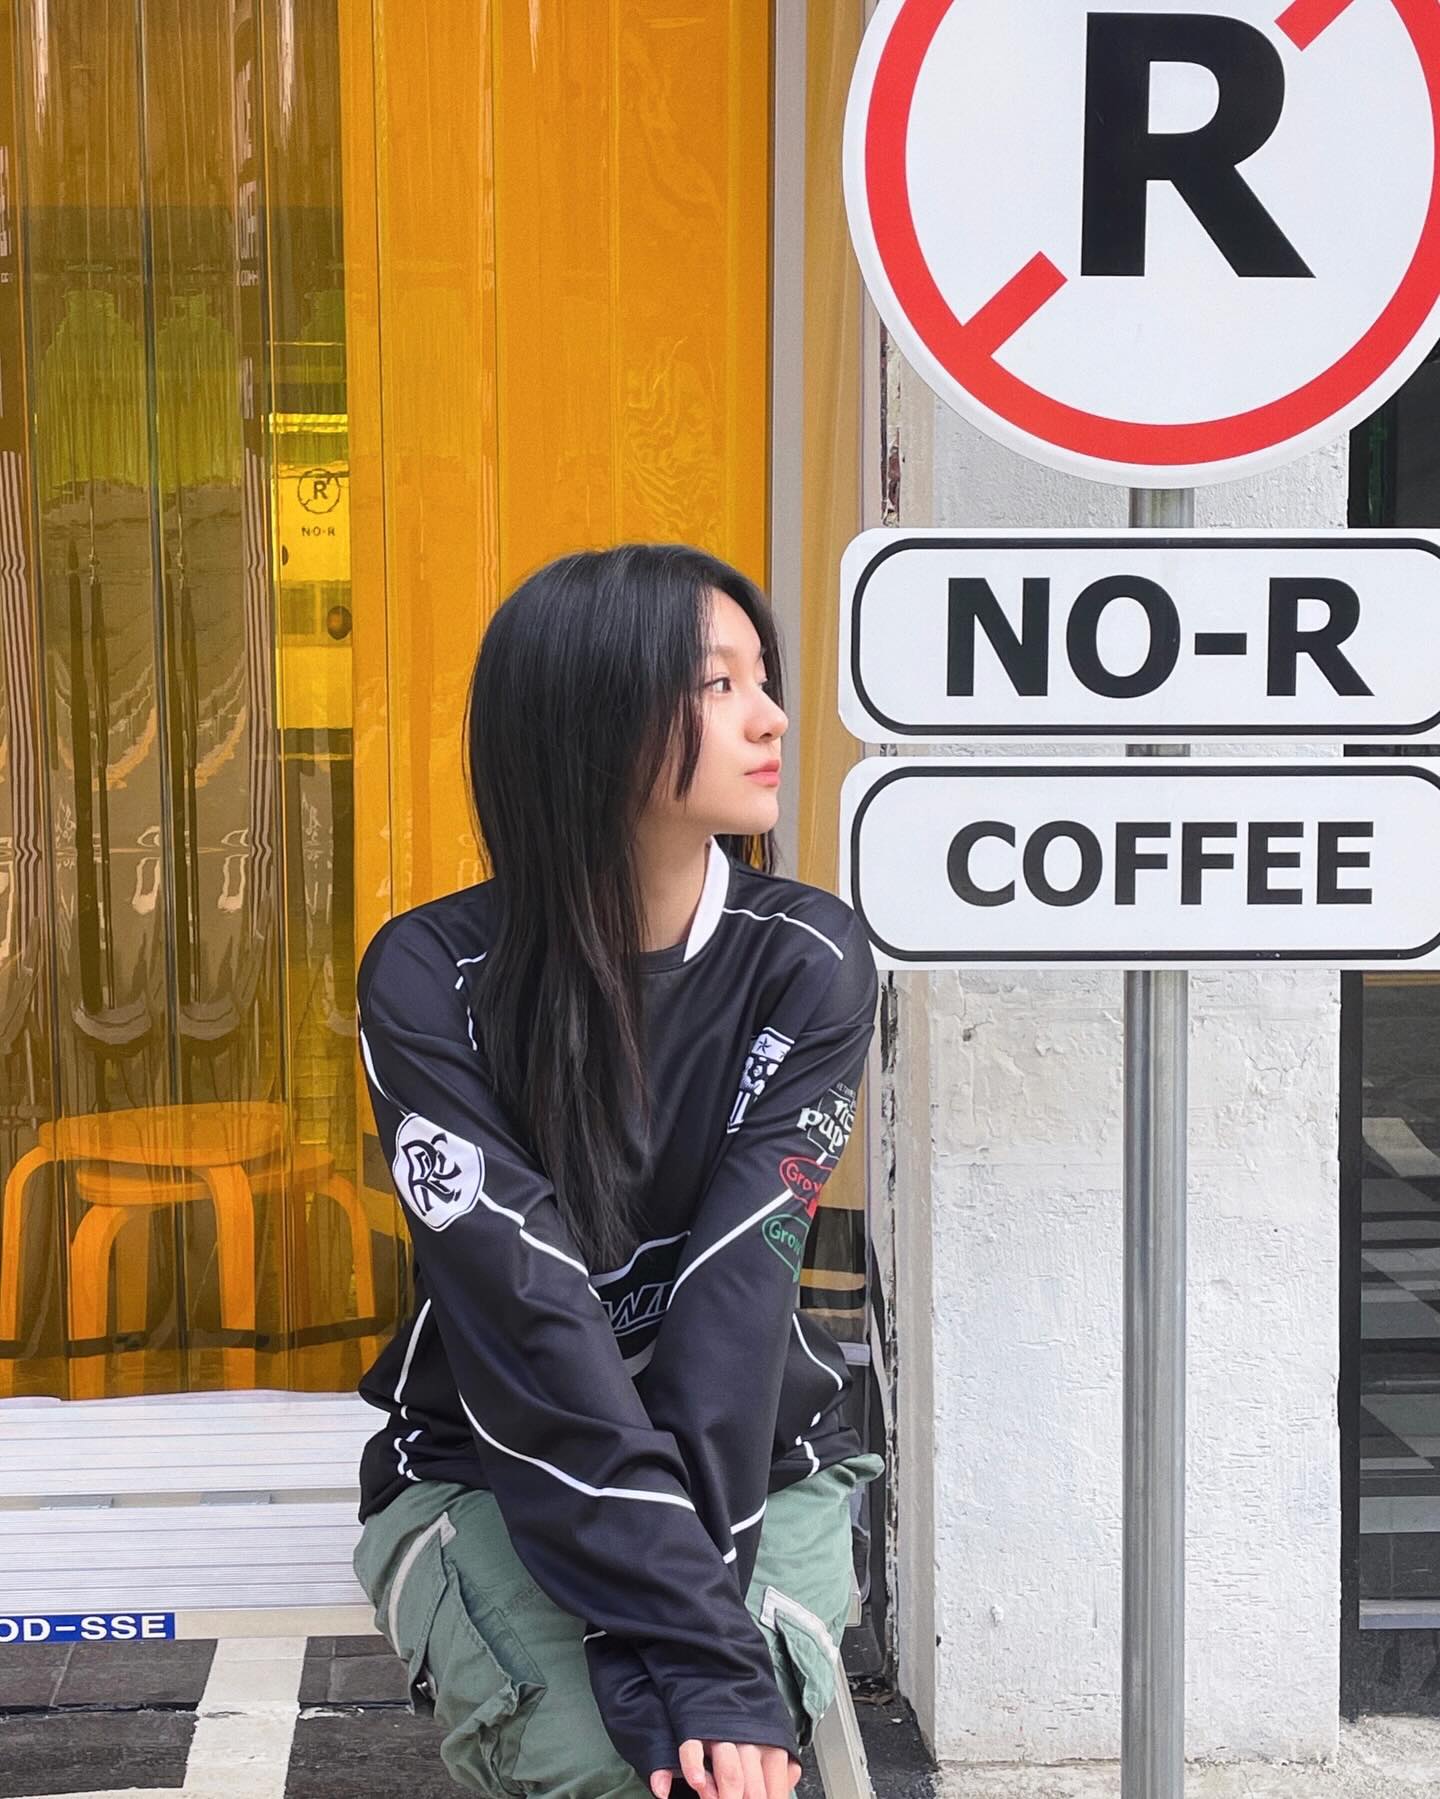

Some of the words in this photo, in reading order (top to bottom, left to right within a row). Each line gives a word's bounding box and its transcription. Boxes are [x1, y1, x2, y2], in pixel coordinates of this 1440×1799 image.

[1081, 12, 1316, 278] R
[313, 480, 328, 500] R
[946, 574, 1375, 699] NO-R
[946, 820, 1374, 907] COFFEE
